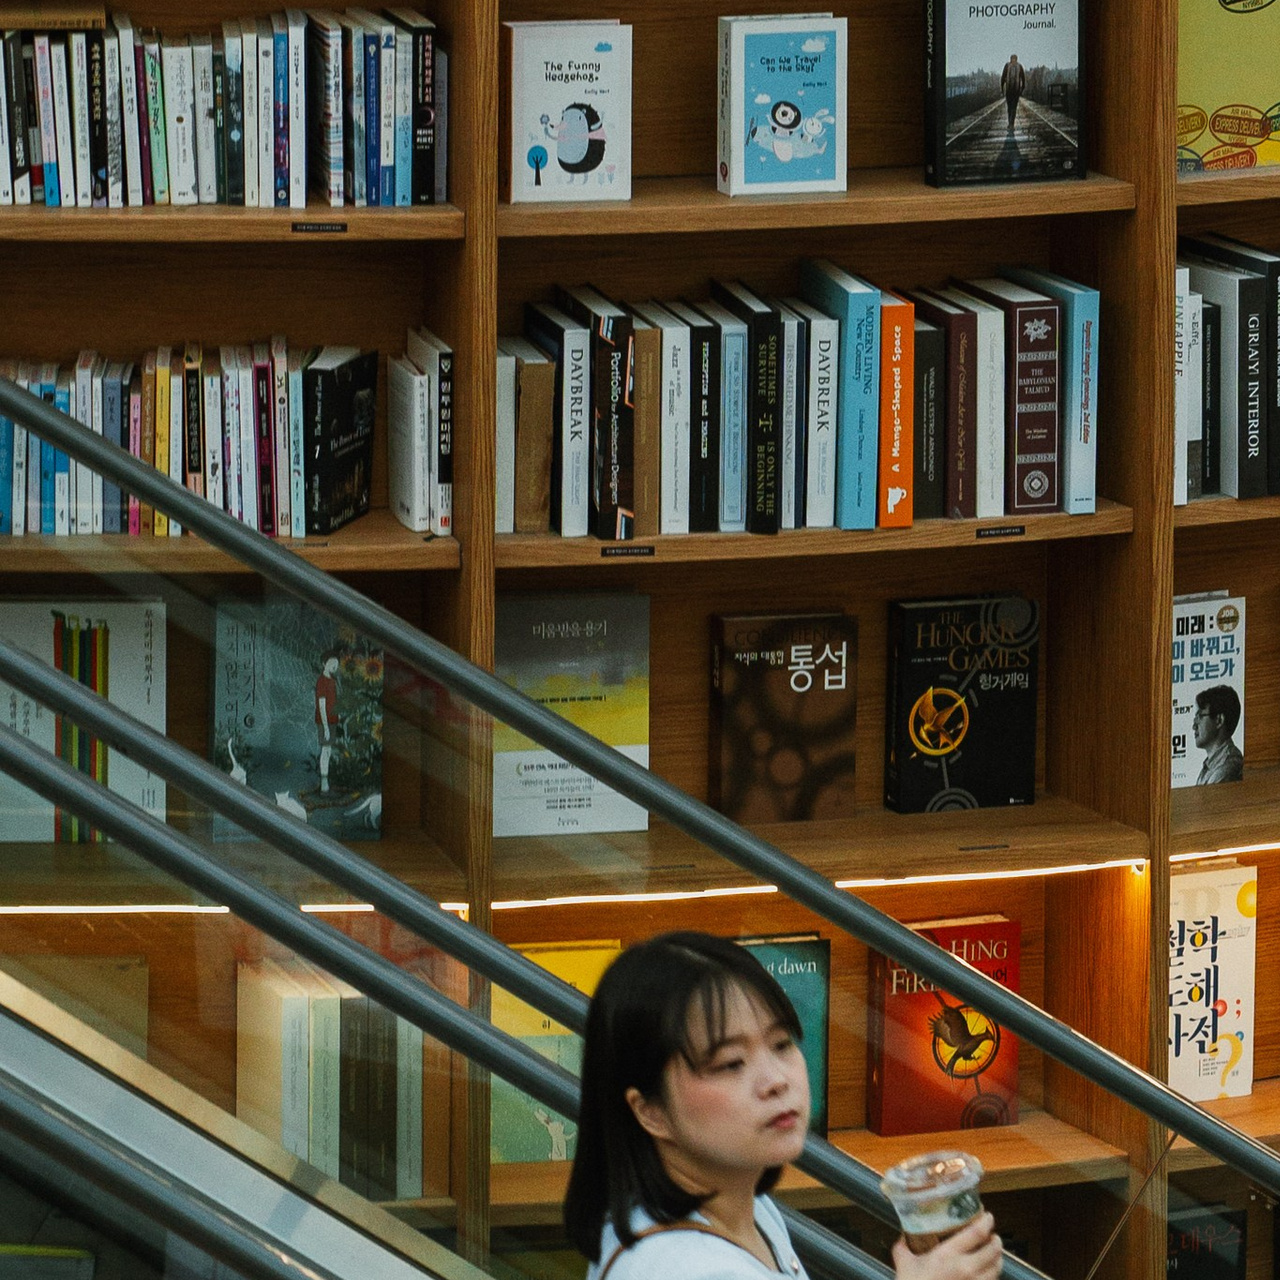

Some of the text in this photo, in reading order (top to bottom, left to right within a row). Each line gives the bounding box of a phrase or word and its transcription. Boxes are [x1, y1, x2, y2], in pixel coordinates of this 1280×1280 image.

[968, 2, 1056, 19] PHOTOGRAPHY
[1022, 20, 1057, 31] Journal.
[543, 61, 601, 73] The Funny
[544, 72, 599, 83] Hedgehog.
[767, 63, 815, 73] to the Sky?
[757, 343, 767, 396] SURVIVE
[767, 334, 777, 404] SOMETIMES
[816, 340, 831, 432] DAYBREAK
[1018, 377, 1056, 387] BABYLONIAN
[1024, 385, 1050, 394] TALMUD
[570, 349, 583, 442] DAYBREAK
[891, 325, 902, 472] A Mango-Shaped Space
[755, 446, 765, 512] BEGINNING
[532, 620, 607, 639] 미움받을 용기
[915, 619, 1015, 649] HUNGER
[787, 641, 847, 693] 통섭
[948, 647, 1030, 672] GAMES
